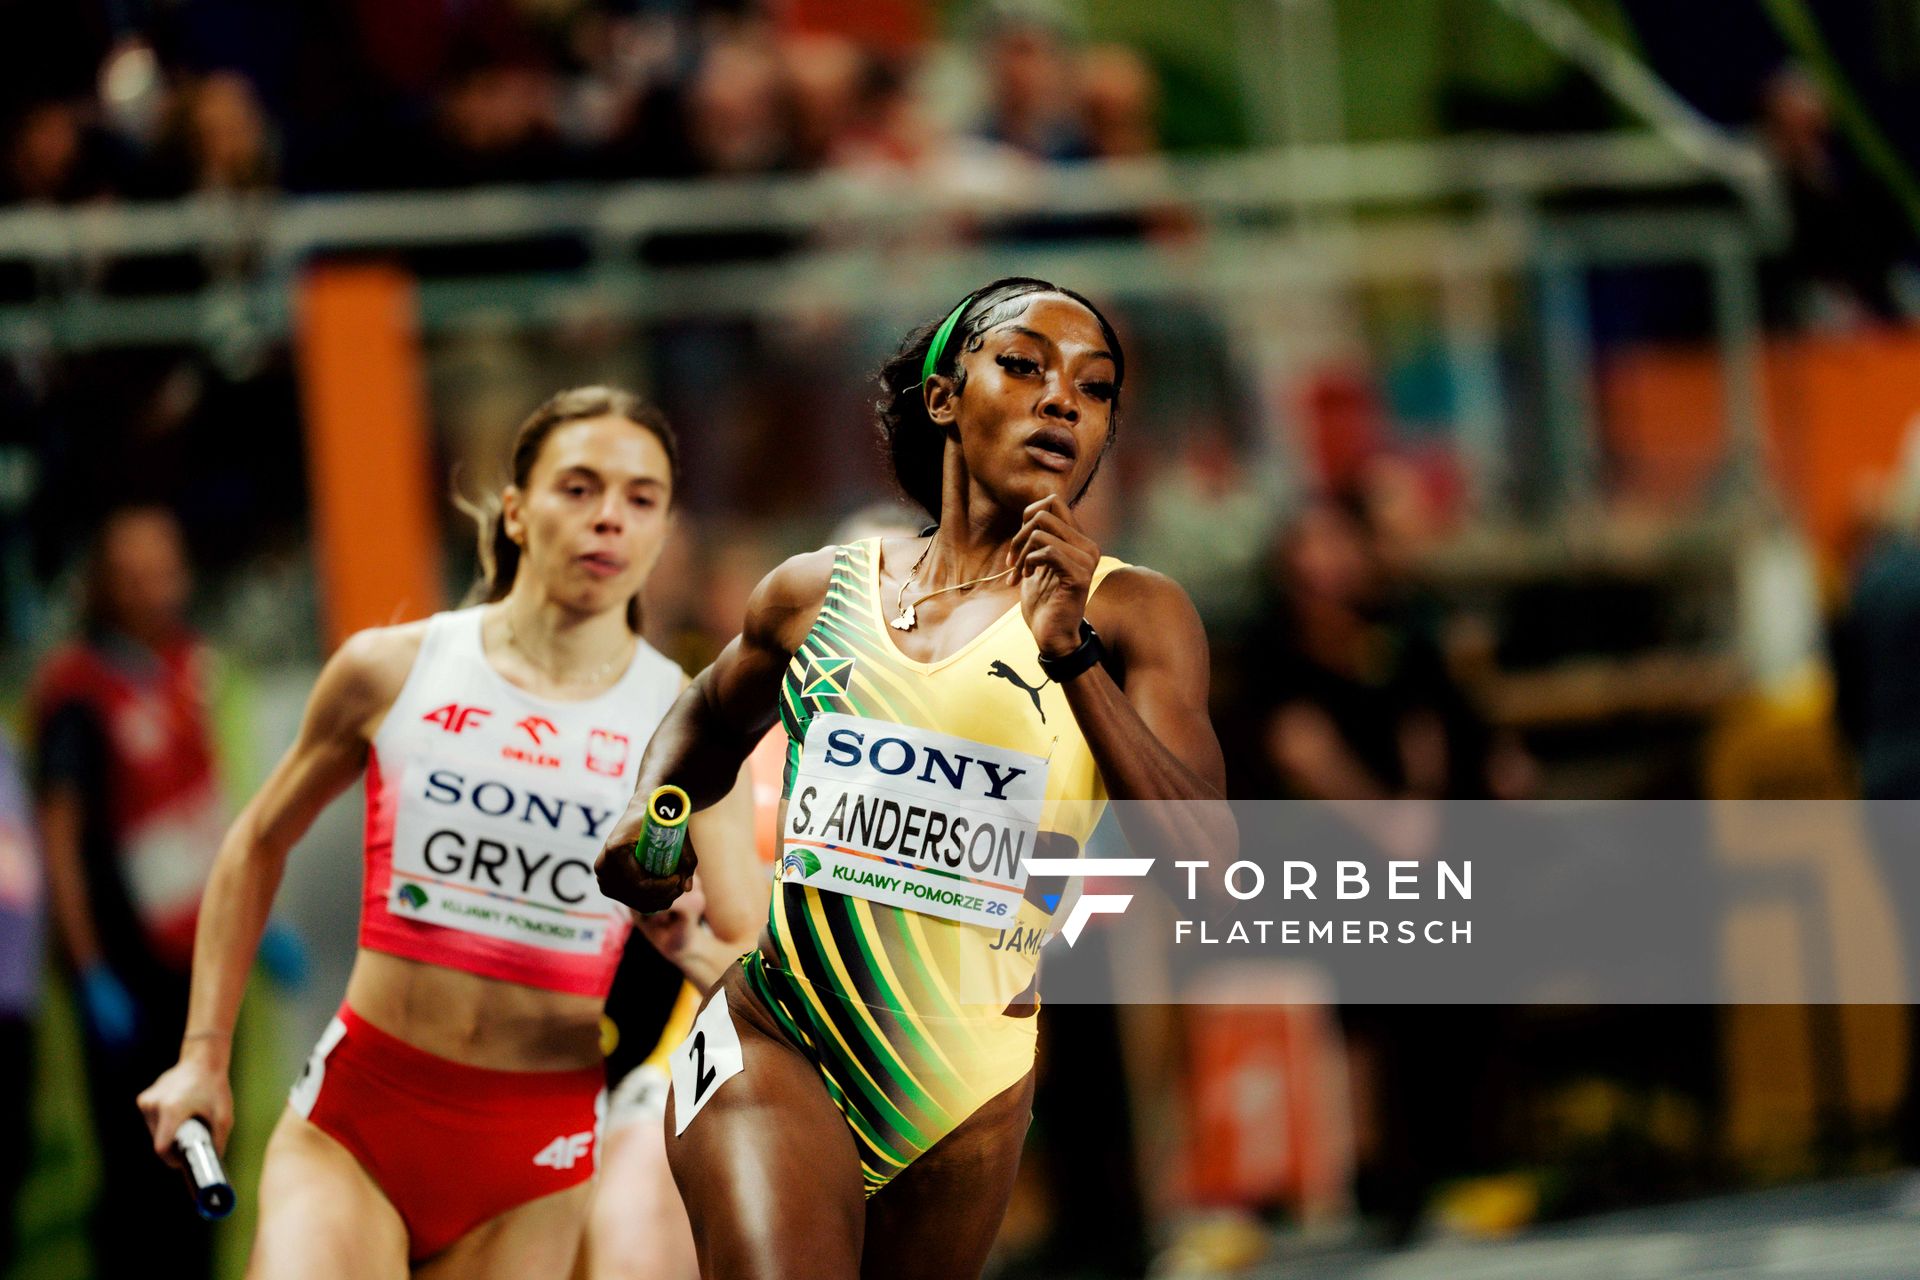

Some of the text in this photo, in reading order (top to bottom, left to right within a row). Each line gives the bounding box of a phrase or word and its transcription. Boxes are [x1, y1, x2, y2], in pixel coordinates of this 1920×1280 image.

[421, 703, 492, 734] 4F
[824, 728, 1026, 801] SONY
[424, 770, 613, 838] SONY
[659, 805, 676, 819] 2
[792, 786, 1026, 880] S. ANDERSON
[424, 829, 592, 904] GRYC
[832, 864, 1008, 916] KUJAWY POMORZE 26
[689, 1030, 716, 1106] 2
[533, 1131, 594, 1170] 4F
